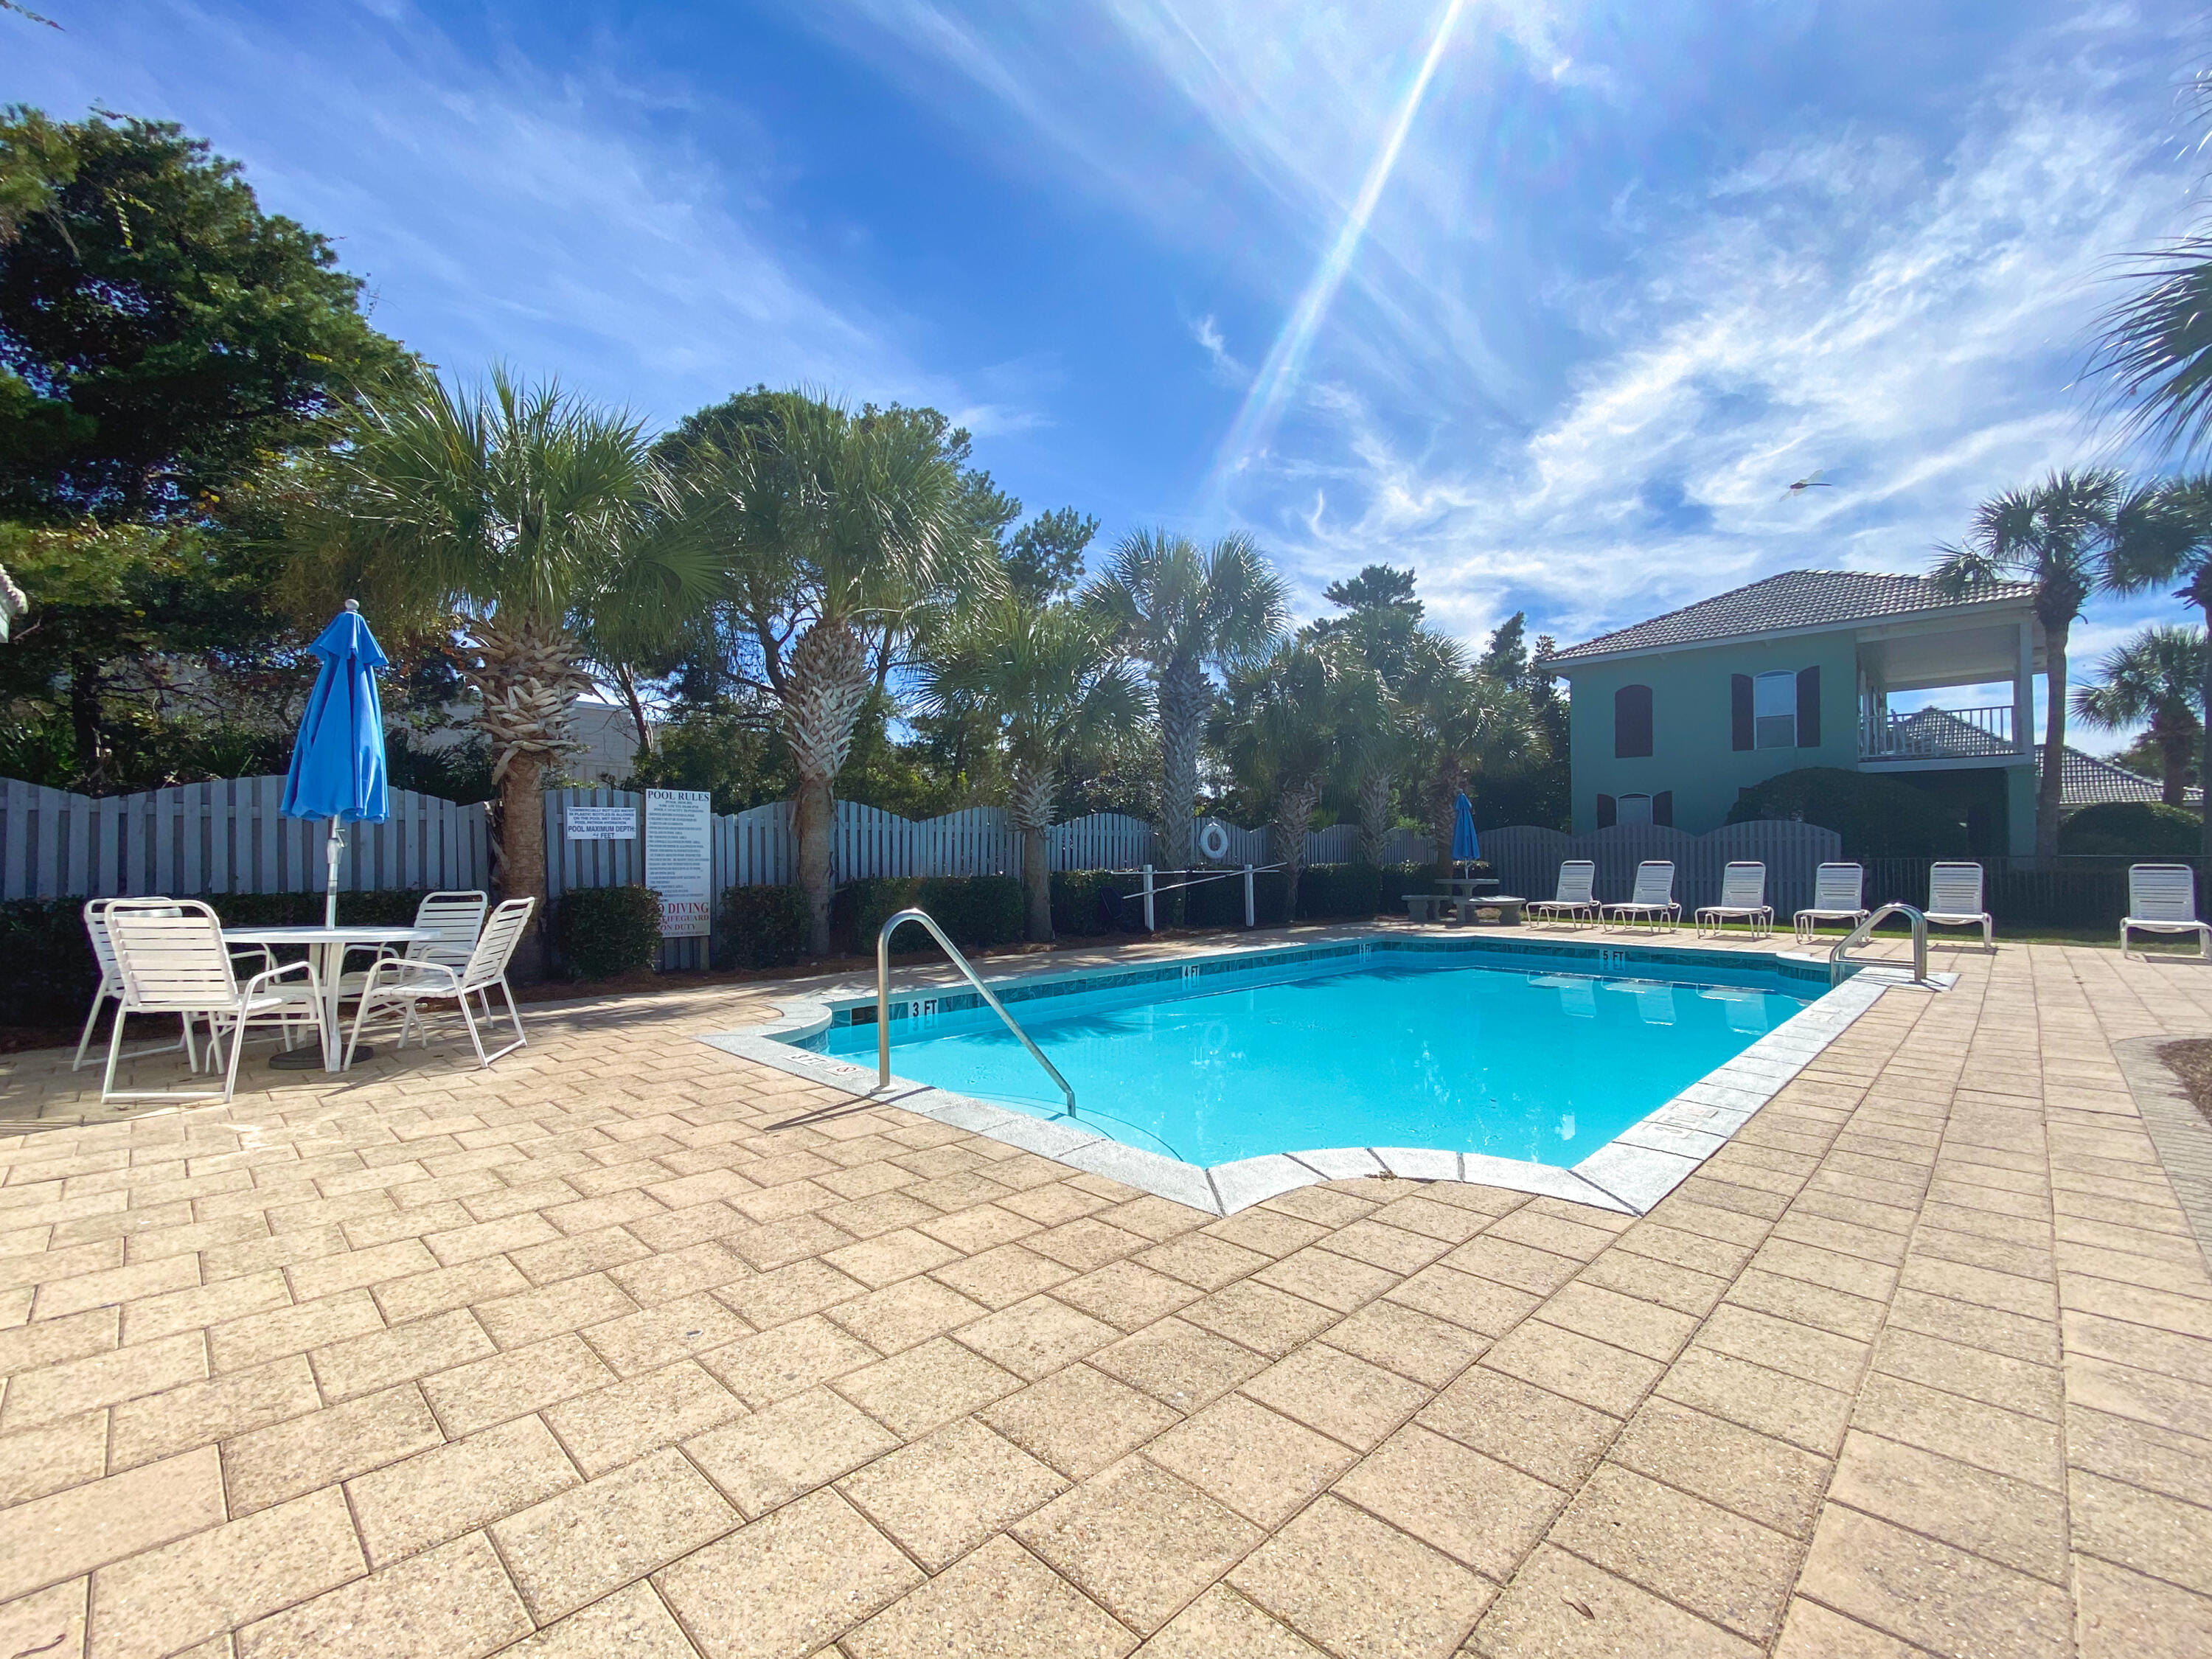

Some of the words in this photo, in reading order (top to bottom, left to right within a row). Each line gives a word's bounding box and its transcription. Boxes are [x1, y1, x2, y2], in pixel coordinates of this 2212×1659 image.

[647, 790, 676, 800] POOL
[678, 792, 709, 802] RULES
[668, 902, 709, 914] DIVING
[1603, 950, 1609, 960] 5
[1613, 951, 1624, 961] FT
[1184, 966, 1189, 978] 4
[1191, 965, 1199, 978] FT
[913, 1001, 919, 1018] 3
[924, 999, 937, 1015] FT
